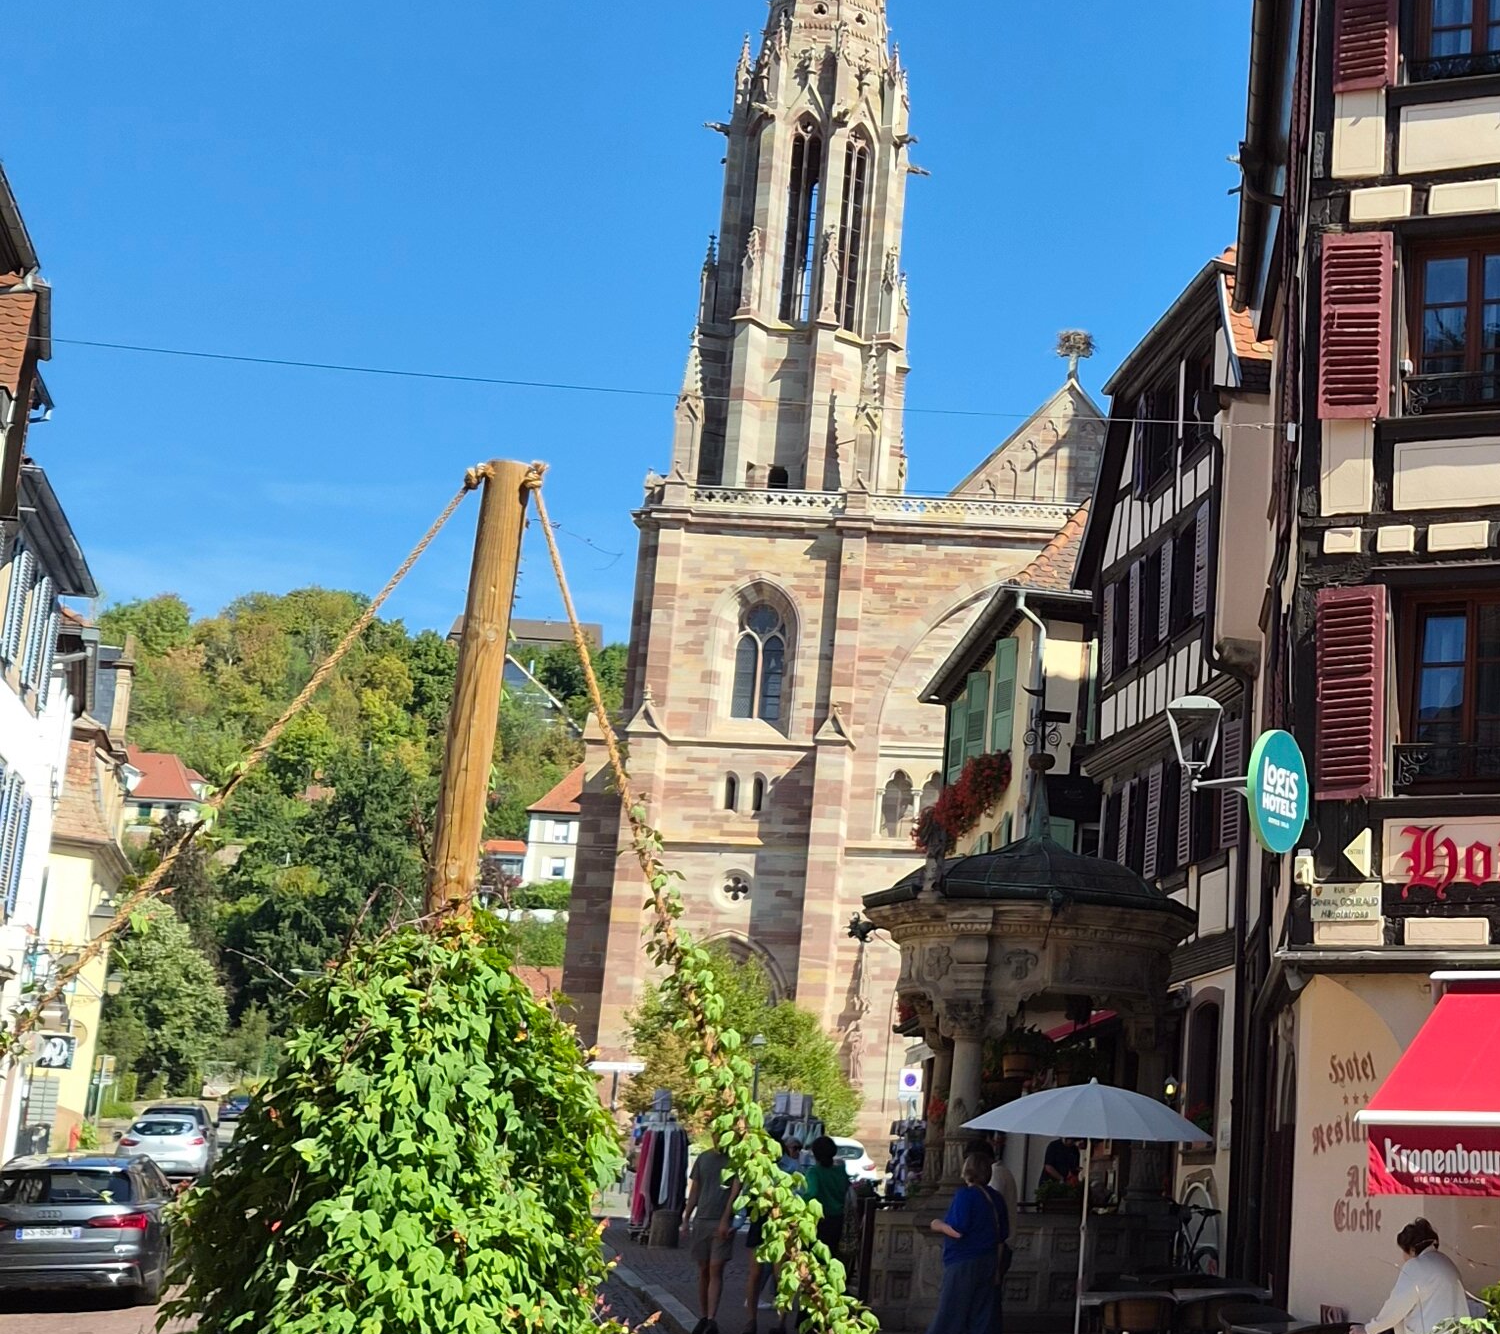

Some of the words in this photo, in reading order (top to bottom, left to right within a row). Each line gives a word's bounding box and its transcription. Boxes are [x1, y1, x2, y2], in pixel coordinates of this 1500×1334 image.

[1262, 791, 1298, 820] HOTELS
[1328, 1050, 1377, 1088] Hotel
[1443, 1176, 1486, 1185] D'ALSACE
[1333, 1198, 1382, 1233] Cloche
